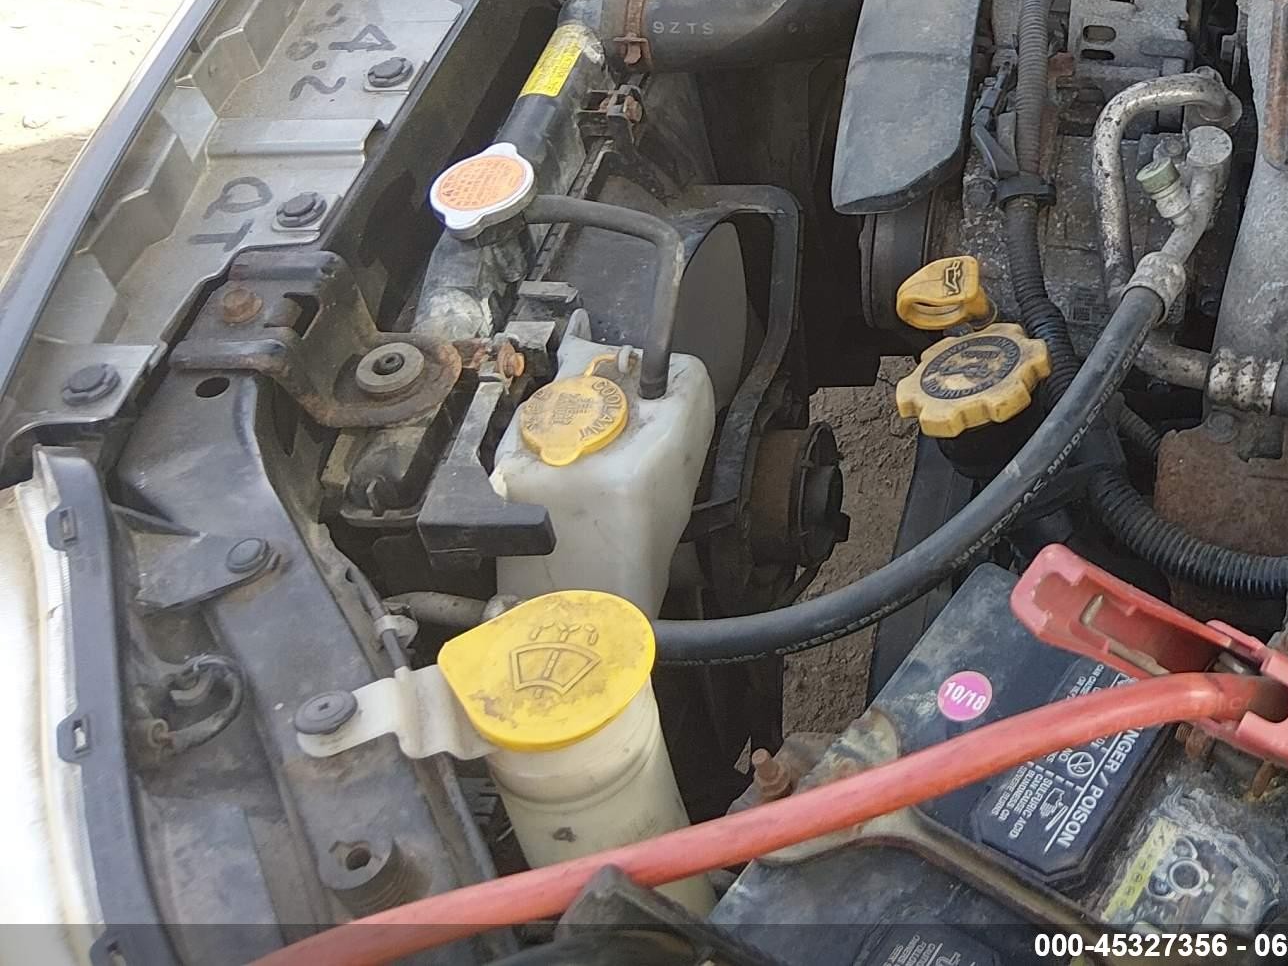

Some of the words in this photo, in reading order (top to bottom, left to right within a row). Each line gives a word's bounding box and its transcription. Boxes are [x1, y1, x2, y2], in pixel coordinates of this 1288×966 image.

[579, 380, 622, 441] COOLANT
[944, 682, 986, 713] 10/18
[1007, 770, 1034, 810] BLINDNESS
[1023, 776, 1053, 820] SULFURIC
[1030, 774, 1044, 791] CAN
[999, 809, 1010, 822] OR
[1013, 790, 1033, 814] CAUSE
[1057, 784, 1105, 850] POISON
[1008, 818, 1026, 840] ACID
